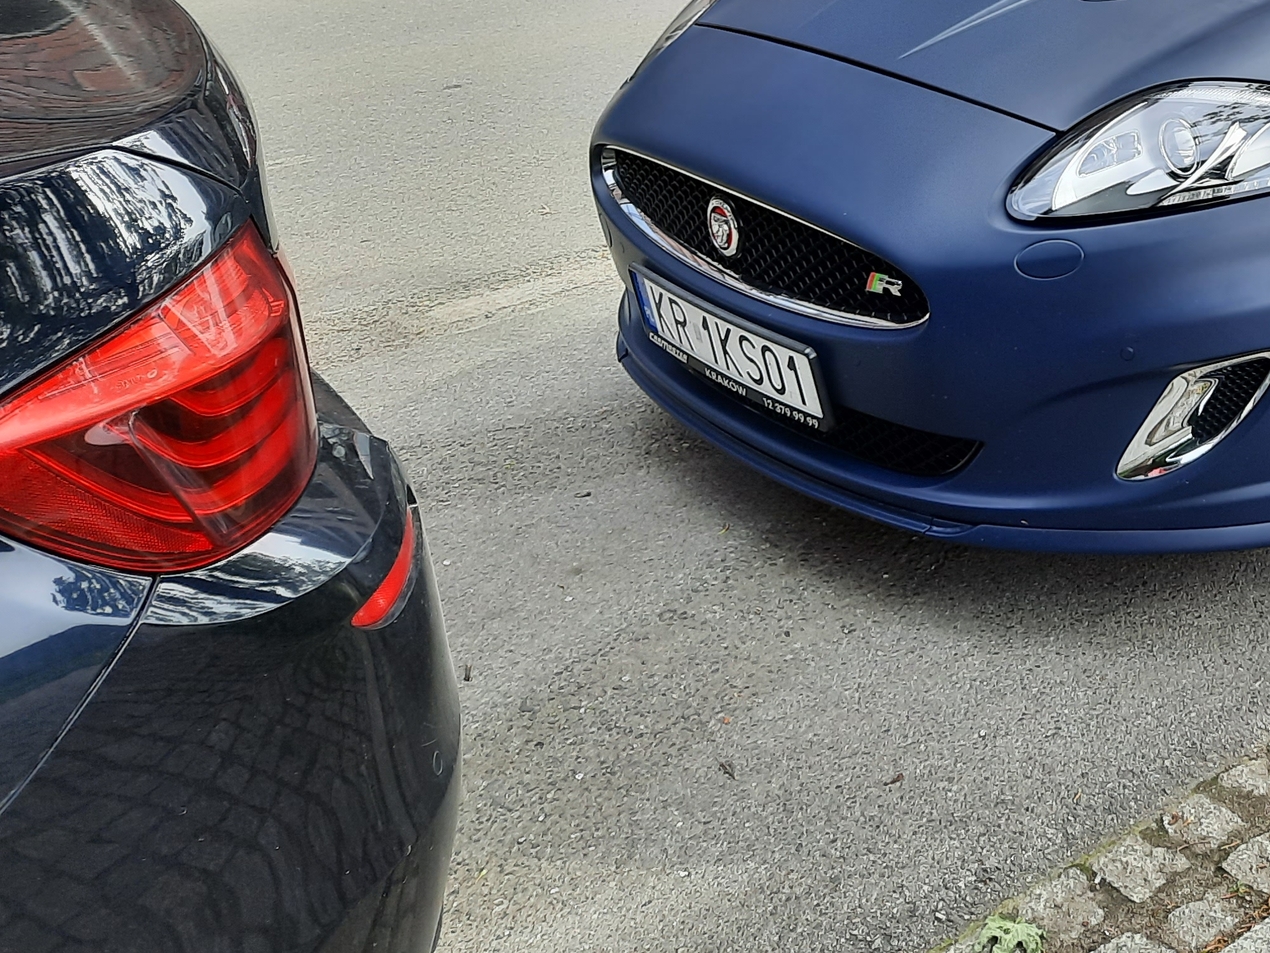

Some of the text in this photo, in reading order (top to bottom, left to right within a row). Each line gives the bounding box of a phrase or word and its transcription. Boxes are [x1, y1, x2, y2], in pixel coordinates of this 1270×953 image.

[649, 285, 809, 407] KR 1KS01
[705, 367, 747, 397] KRAKÓW
[763, 397, 819, 429] 12 379 99 99
